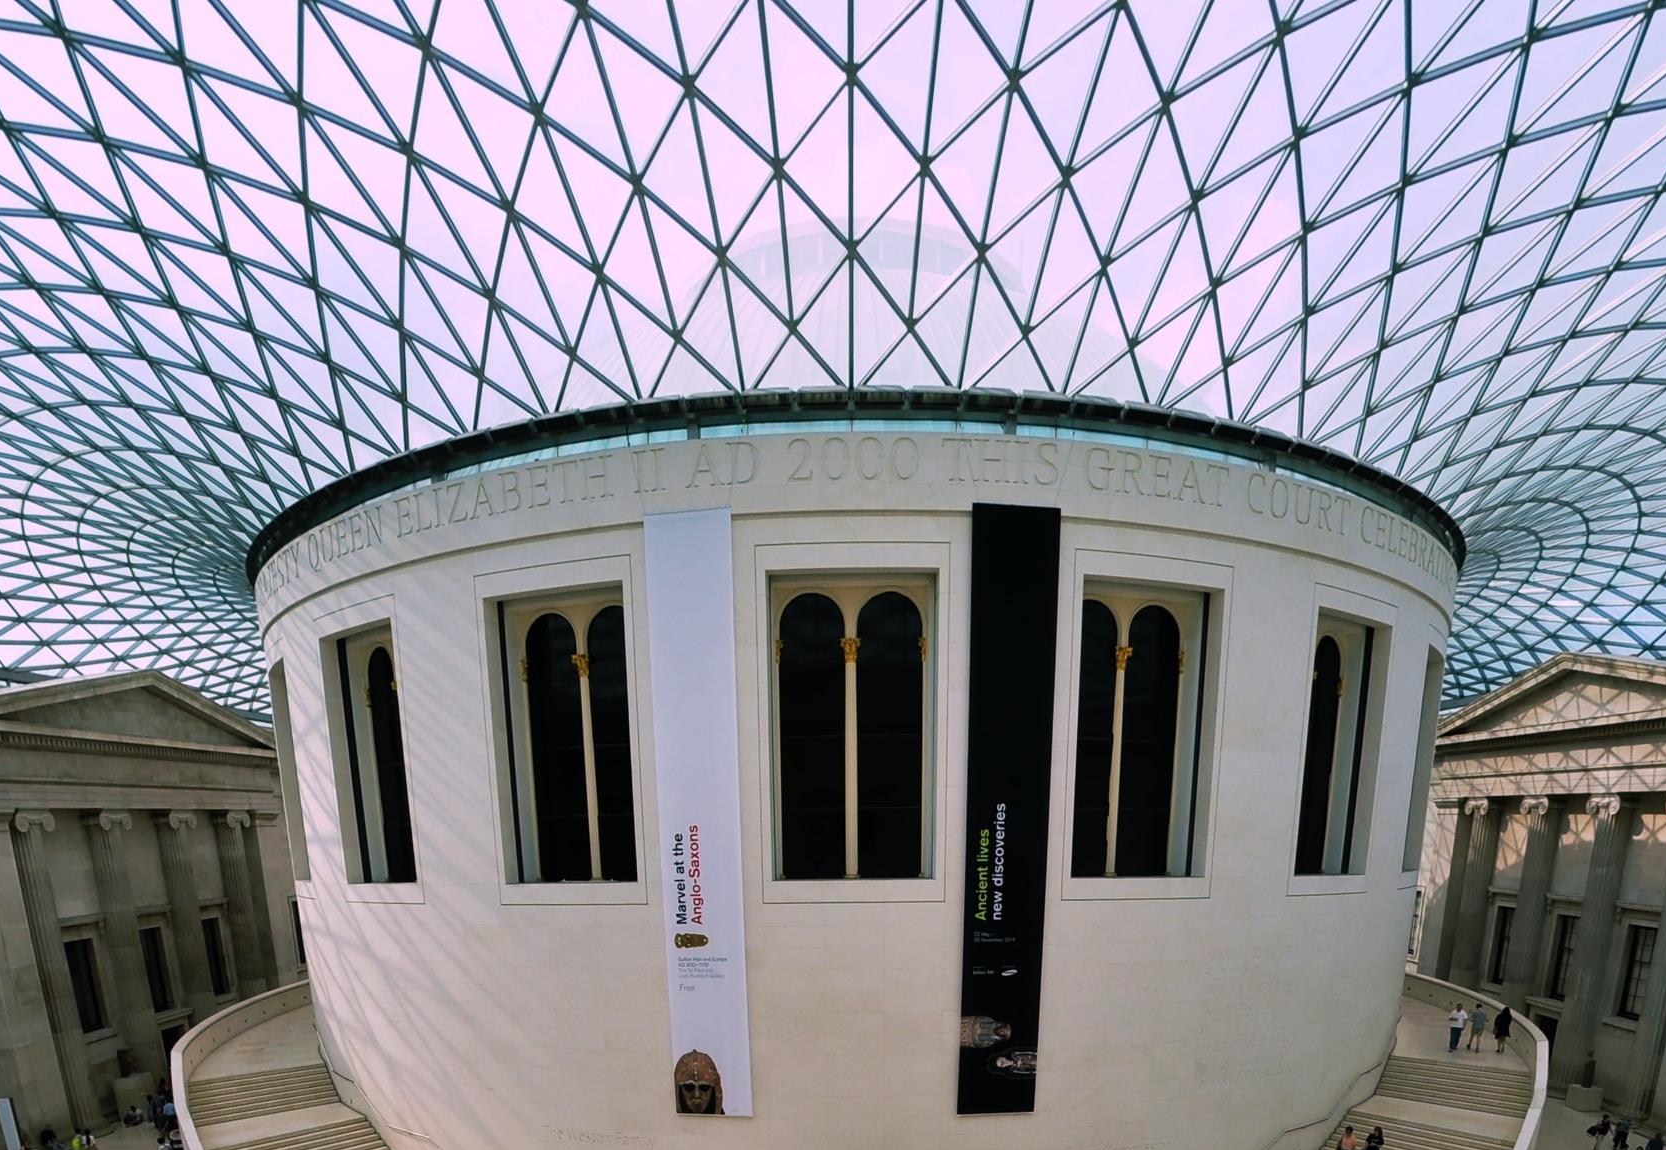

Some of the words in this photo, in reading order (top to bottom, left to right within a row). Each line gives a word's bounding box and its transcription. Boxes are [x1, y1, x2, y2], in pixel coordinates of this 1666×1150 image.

[307, 503, 383, 573] QUEEN
[393, 454, 615, 539] ELIZABETH
[631, 447, 667, 494] II
[685, 440, 760, 488] AD
[787, 435, 919, 483] 2000
[941, 437, 1059, 486] THIS
[1084, 446, 1230, 508] GREAT
[1246, 472, 1351, 537] COURT
[671, 832, 684, 857] the
[977, 828, 990, 862] lives
[992, 803, 1006, 887] discoveries
[675, 859, 685, 875] at
[687, 824, 704, 926] Anglo-Saxons
[674, 878, 688, 925] Marvel
[974, 865, 988, 921] Ancient
[992, 891, 1003, 921] new
[678, 983, 695, 992] Free
